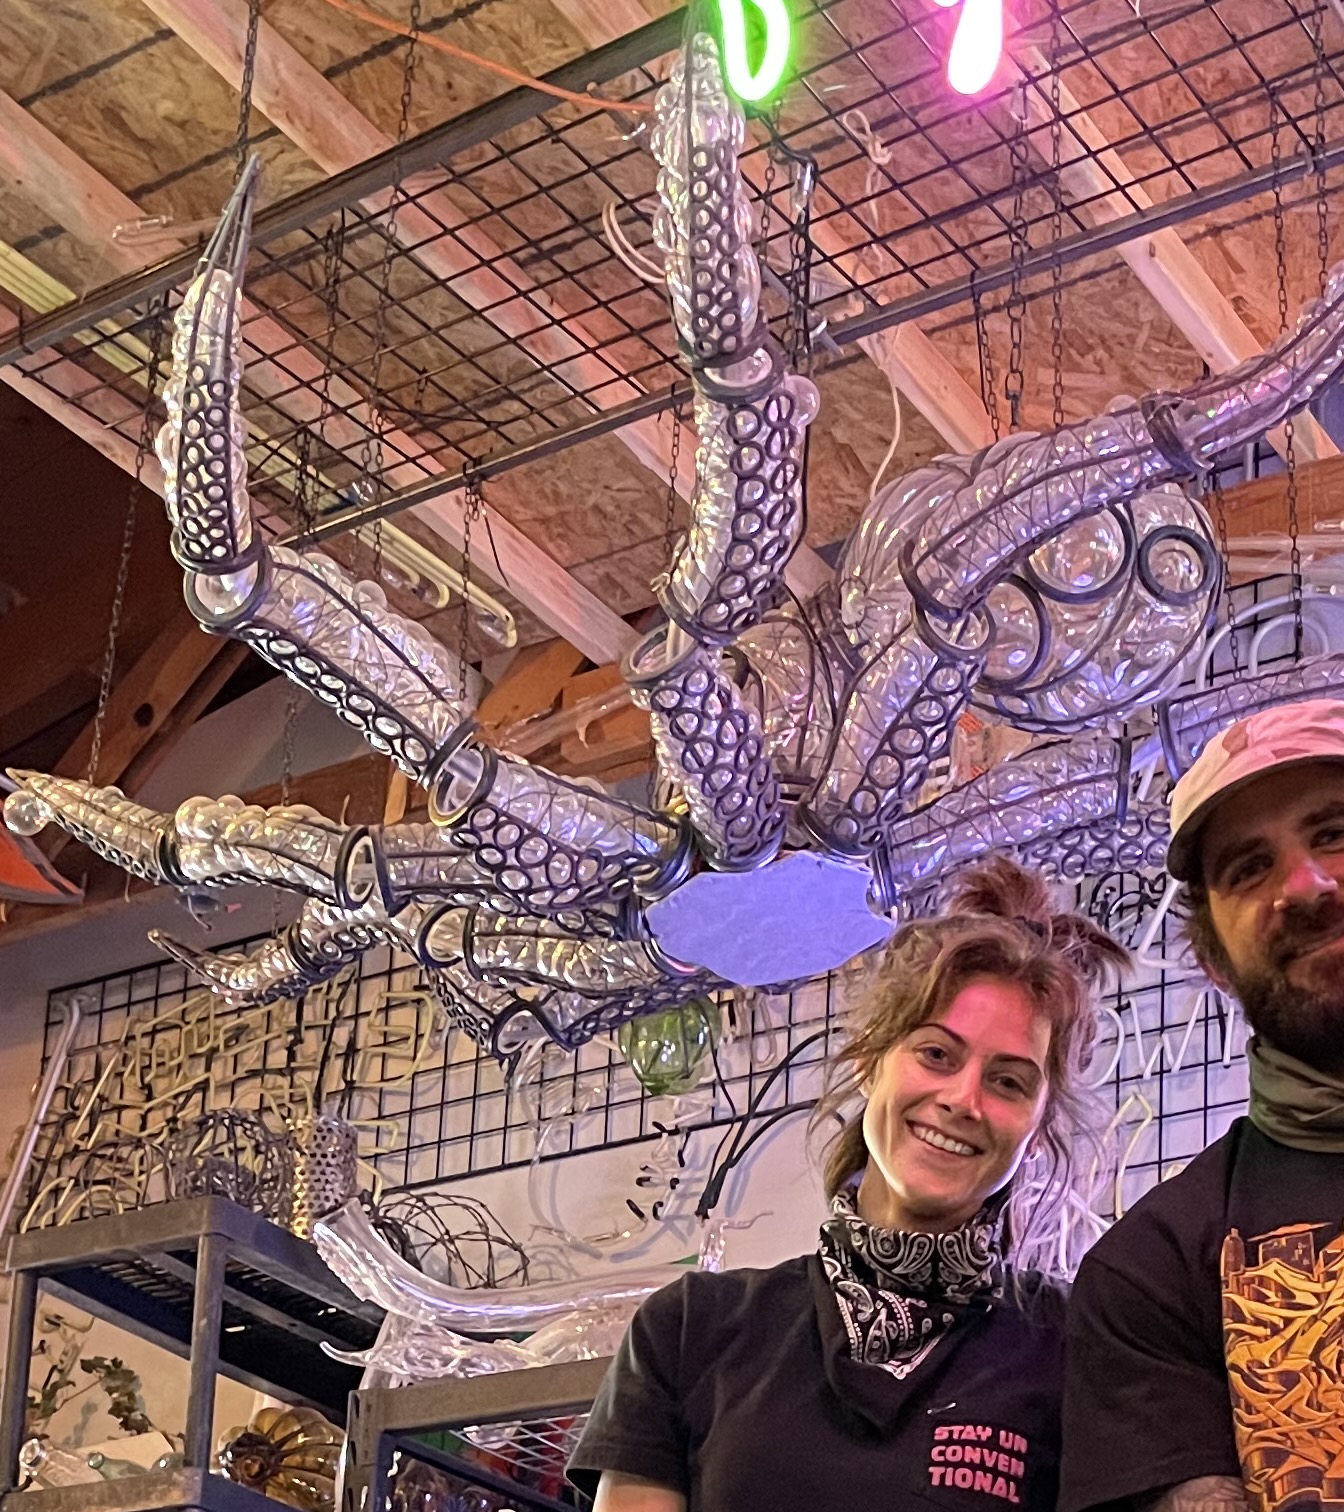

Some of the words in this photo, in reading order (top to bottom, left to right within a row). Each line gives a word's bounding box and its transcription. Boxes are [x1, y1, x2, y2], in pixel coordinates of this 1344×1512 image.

[933, 1424, 993, 1442] STAY
[998, 1429, 1029, 1454] UN
[930, 1445, 1026, 1479] CONVEN
[928, 1465, 1021, 1504] TIONAL
